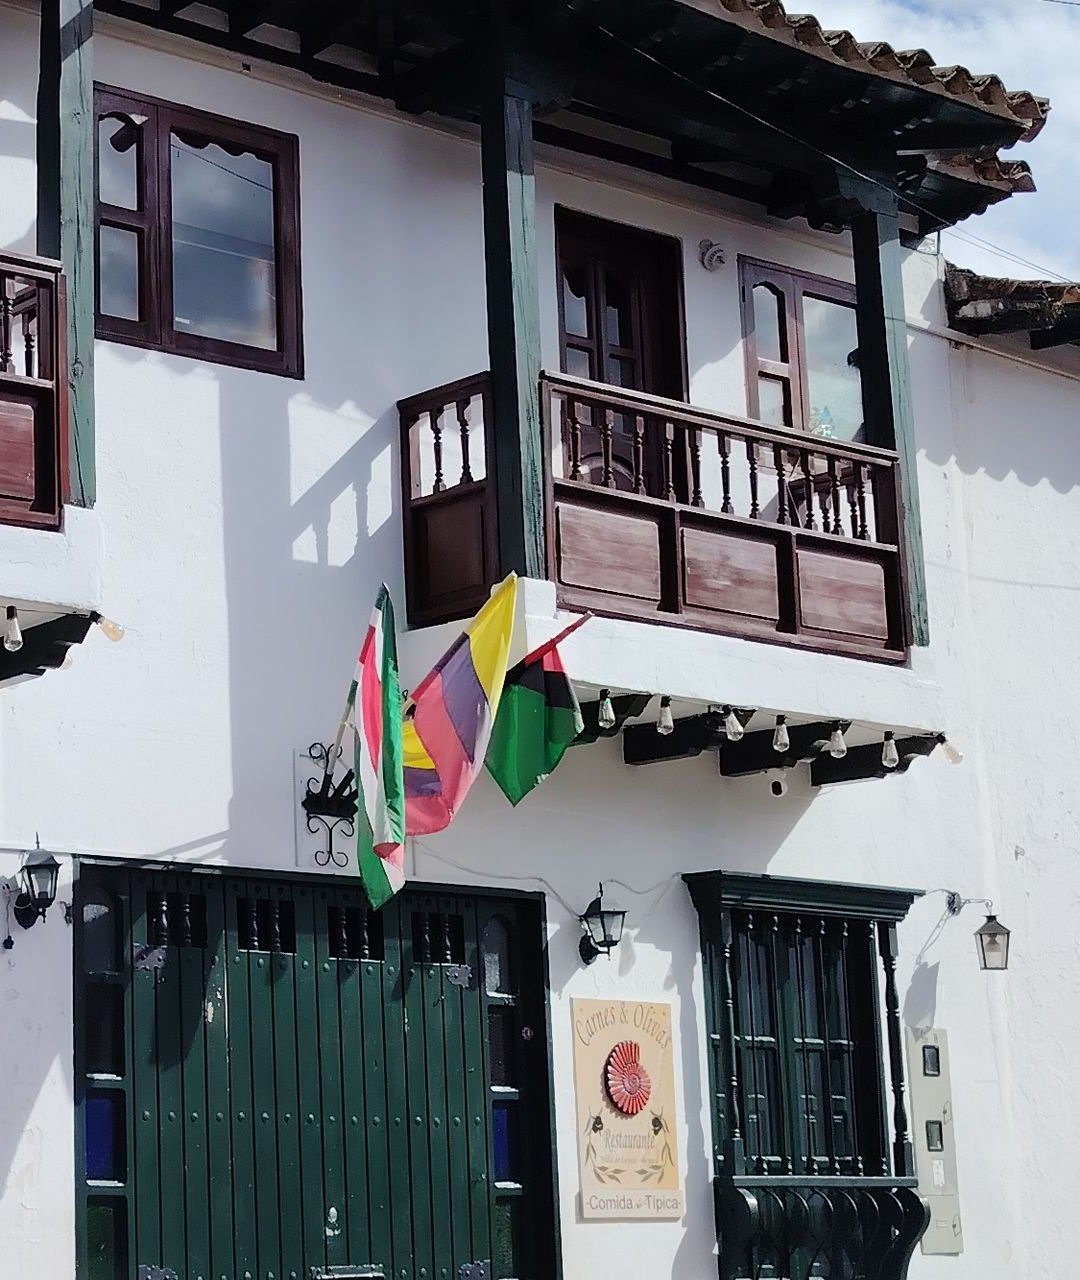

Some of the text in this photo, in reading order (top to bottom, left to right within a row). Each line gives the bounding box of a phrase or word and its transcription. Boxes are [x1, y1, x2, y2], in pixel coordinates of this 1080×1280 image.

[576, 1006, 617, 1046] Carnes
[633, 1004, 672, 1049] Olivas
[603, 1128, 656, 1152] Restaurante
[589, 1195, 633, 1210] Comida
